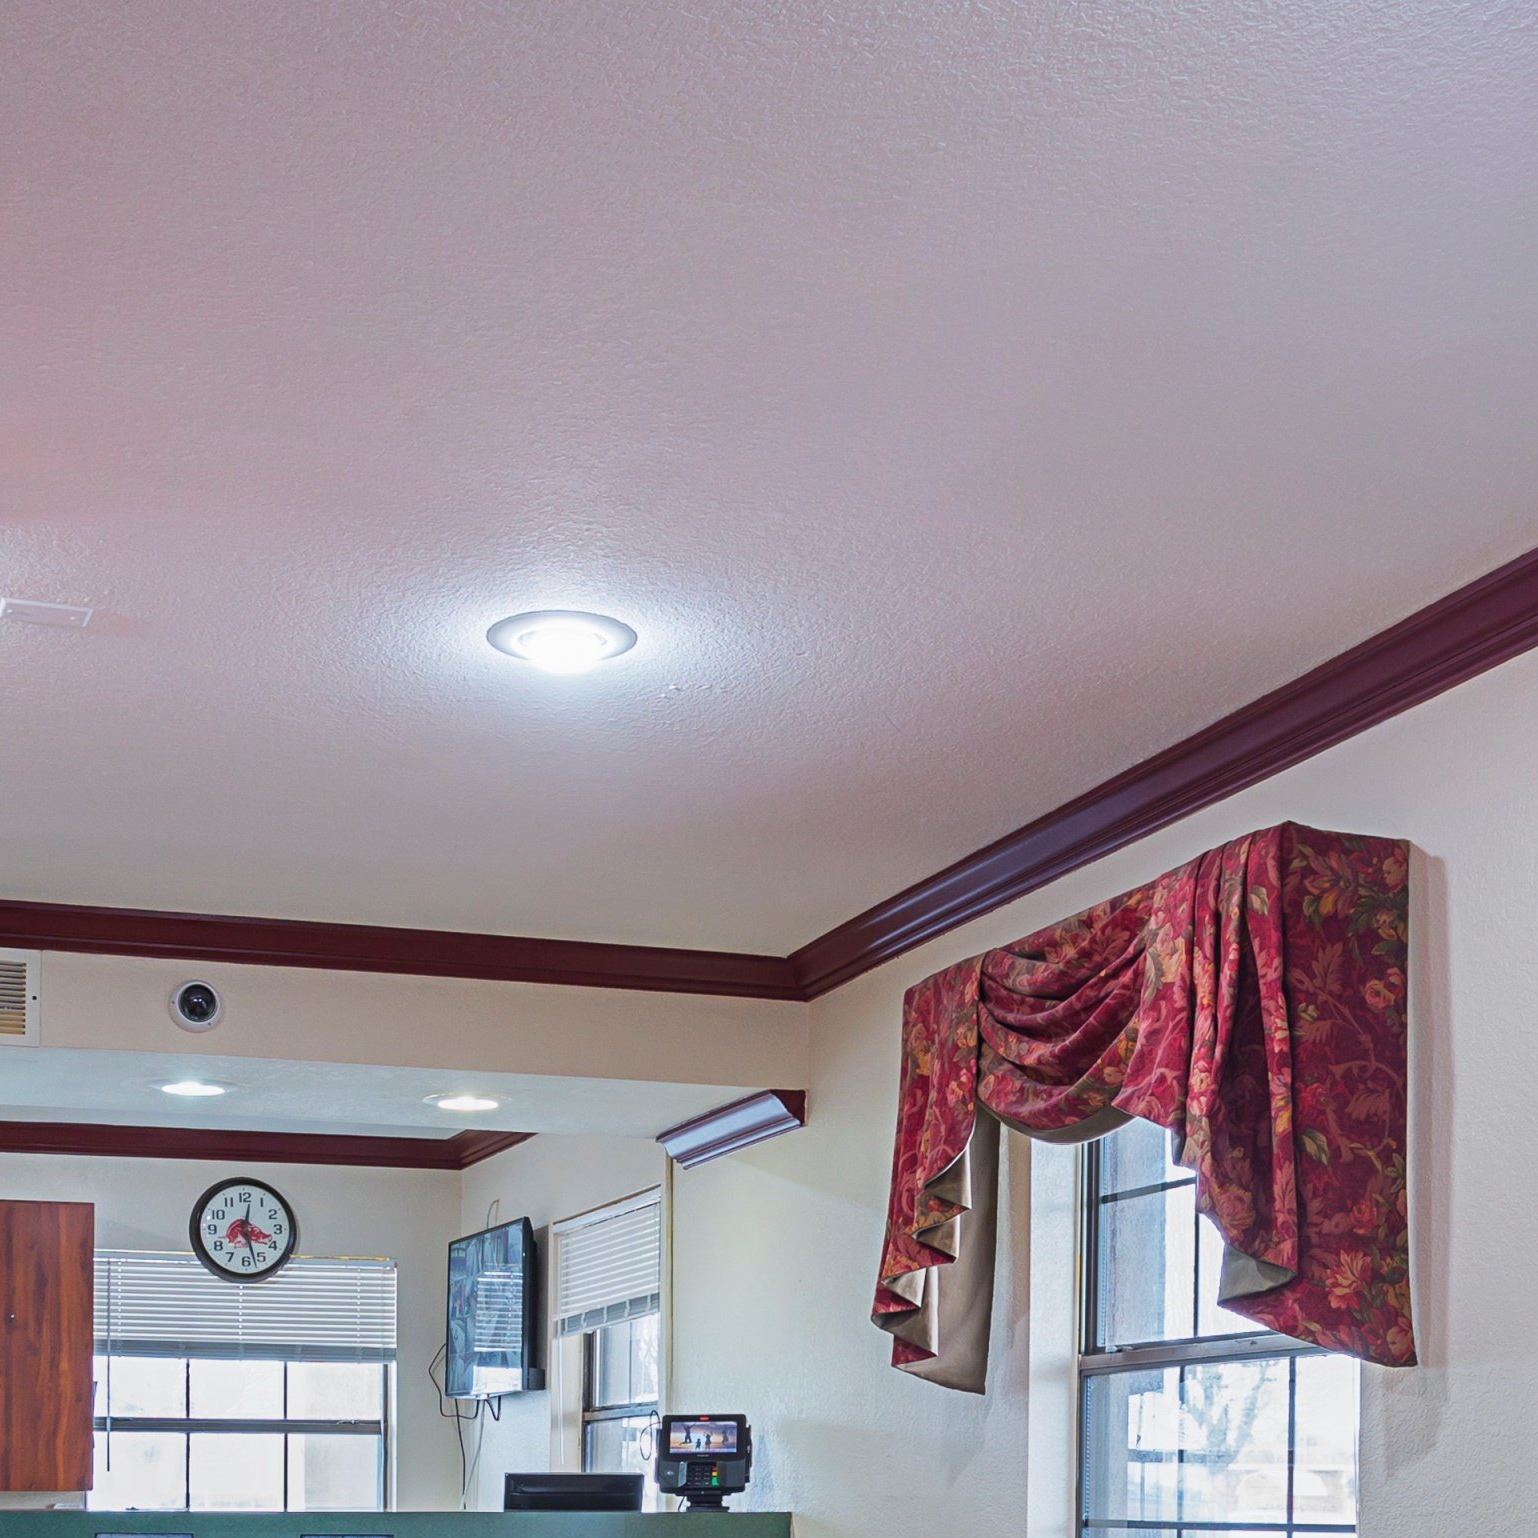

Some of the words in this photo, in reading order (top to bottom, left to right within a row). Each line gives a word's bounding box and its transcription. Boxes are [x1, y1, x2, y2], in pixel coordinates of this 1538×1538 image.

[224, 1197, 234, 1207] 11
[238, 1192, 252, 1203] 12
[260, 1197, 264, 1208] 1
[211, 1209, 225, 1220] 10
[268, 1209, 278, 1220] 2
[207, 1224, 217, 1235] 9
[273, 1224, 283, 1235] 3
[213, 1240, 223, 1251] 8
[268, 1240, 278, 1251] 4
[225, 1252, 235, 1263] 7
[242, 1256, 251, 1267] 6
[256, 1252, 266, 1263] 5
